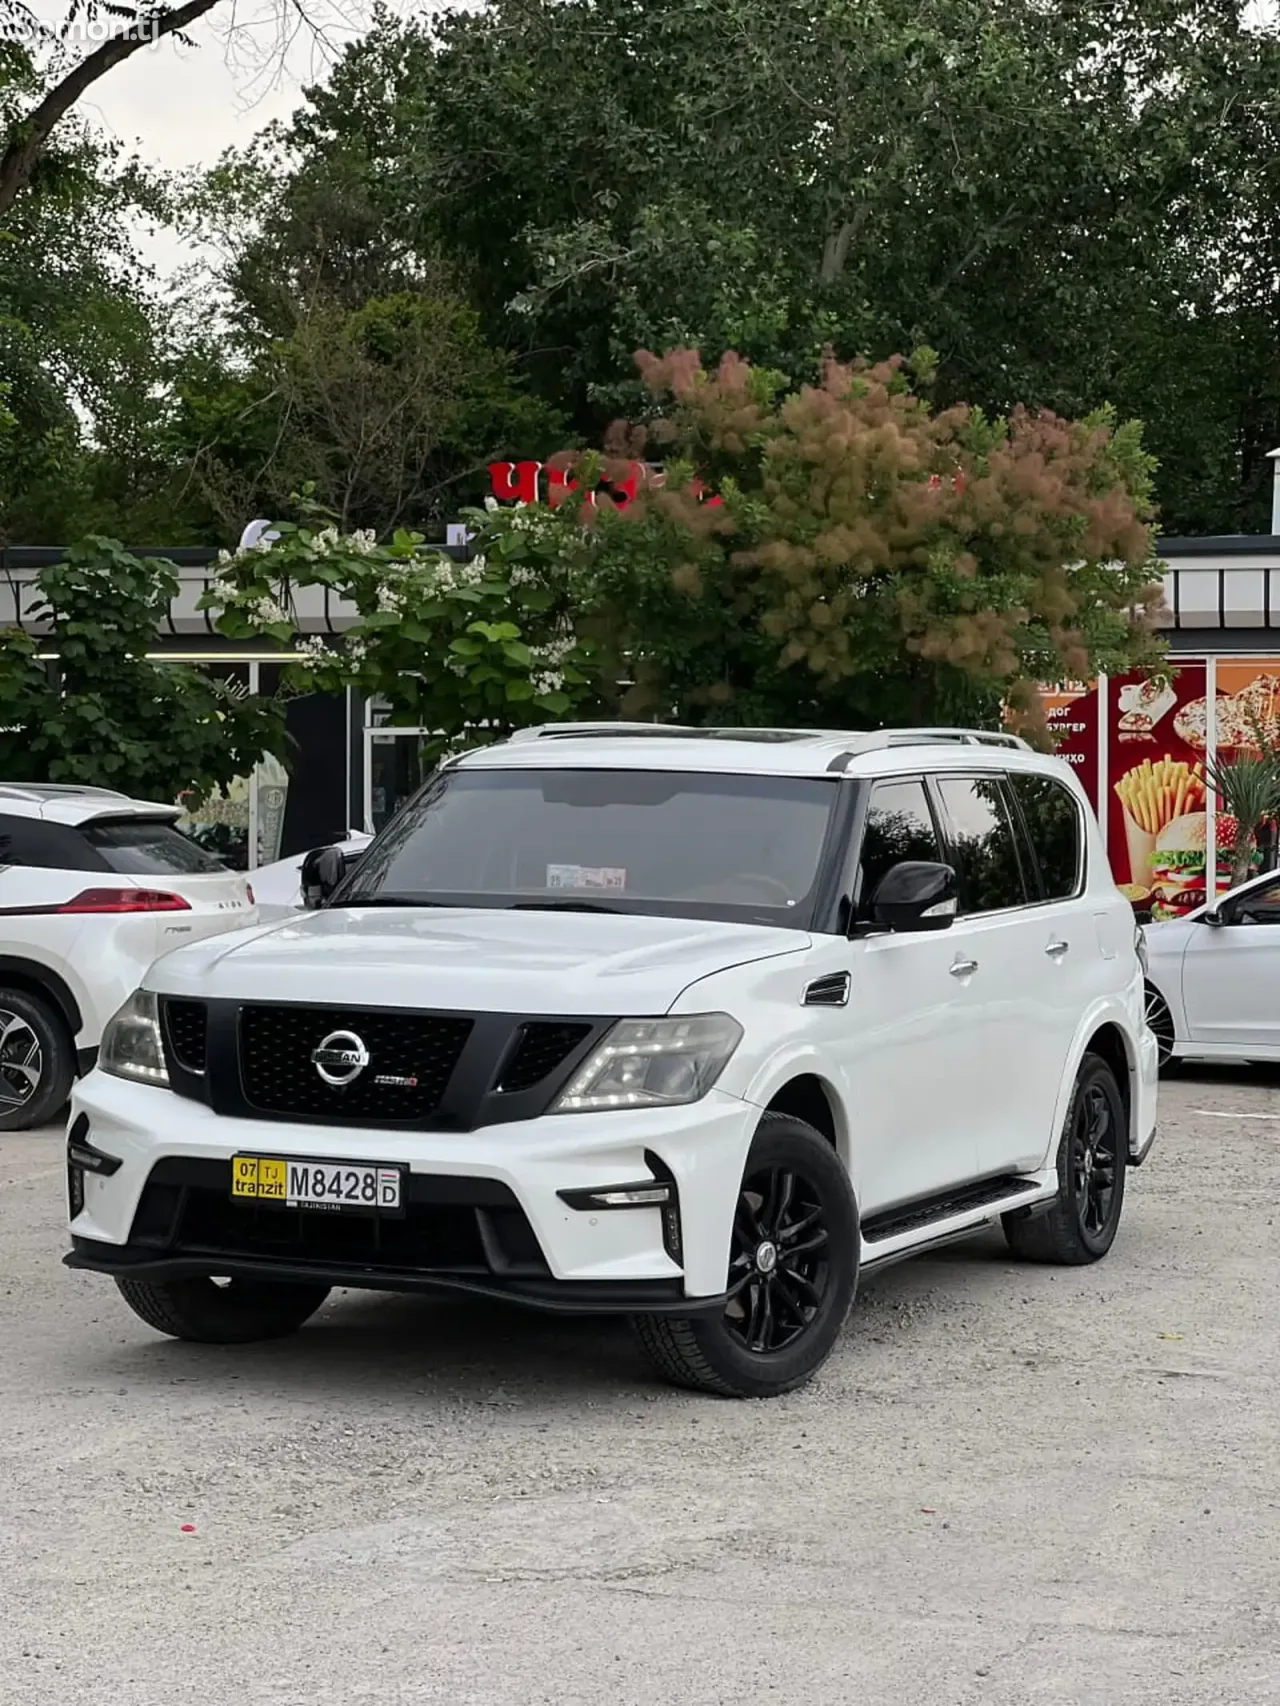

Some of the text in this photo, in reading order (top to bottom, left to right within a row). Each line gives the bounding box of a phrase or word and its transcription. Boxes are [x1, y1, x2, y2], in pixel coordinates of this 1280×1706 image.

[239, 1162, 279, 1179] 07 TJ
[235, 1178, 284, 1196] tranzit
[290, 1166, 377, 1201] M8428
[382, 1185, 397, 1204] D
